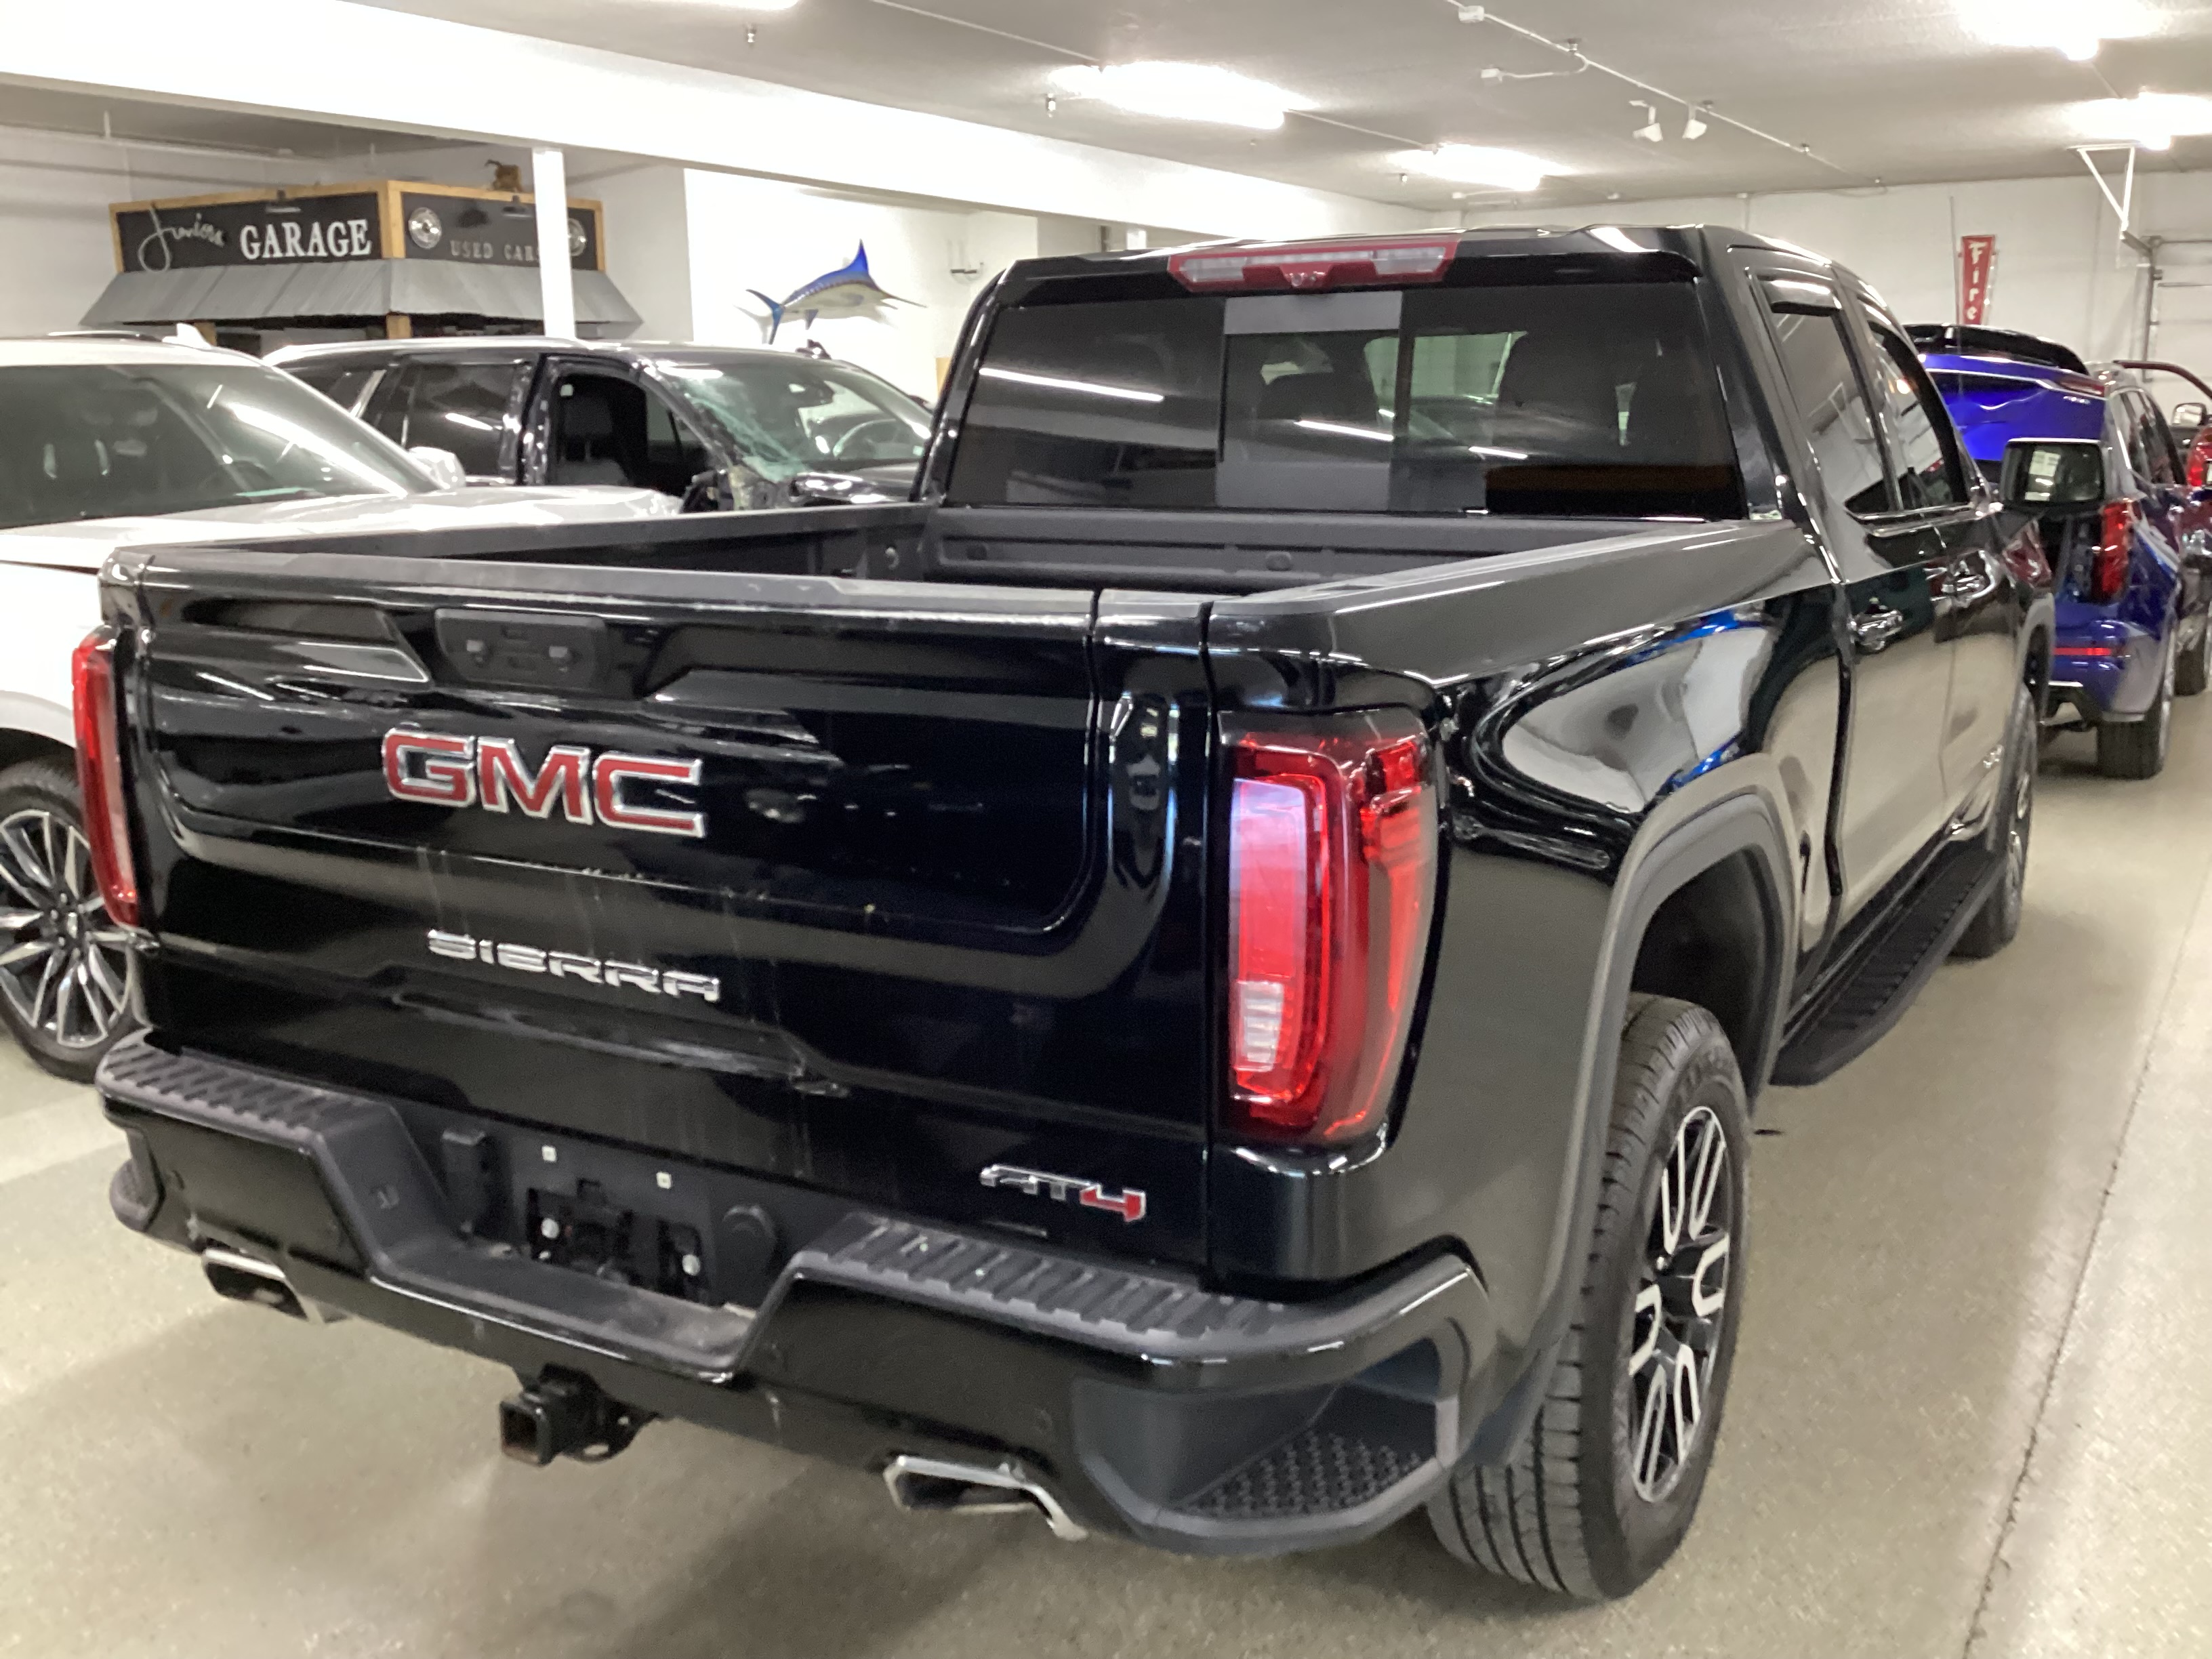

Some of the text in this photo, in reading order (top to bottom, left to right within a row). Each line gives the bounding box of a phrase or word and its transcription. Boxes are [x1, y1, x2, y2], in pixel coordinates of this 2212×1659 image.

[239, 219, 372, 260] GARAGE
[450, 240, 540, 262] USED CAR
[381, 727, 706, 839] GMC
[427, 928, 720, 1003] SIERRA
[980, 1164, 1147, 1223] AT4
